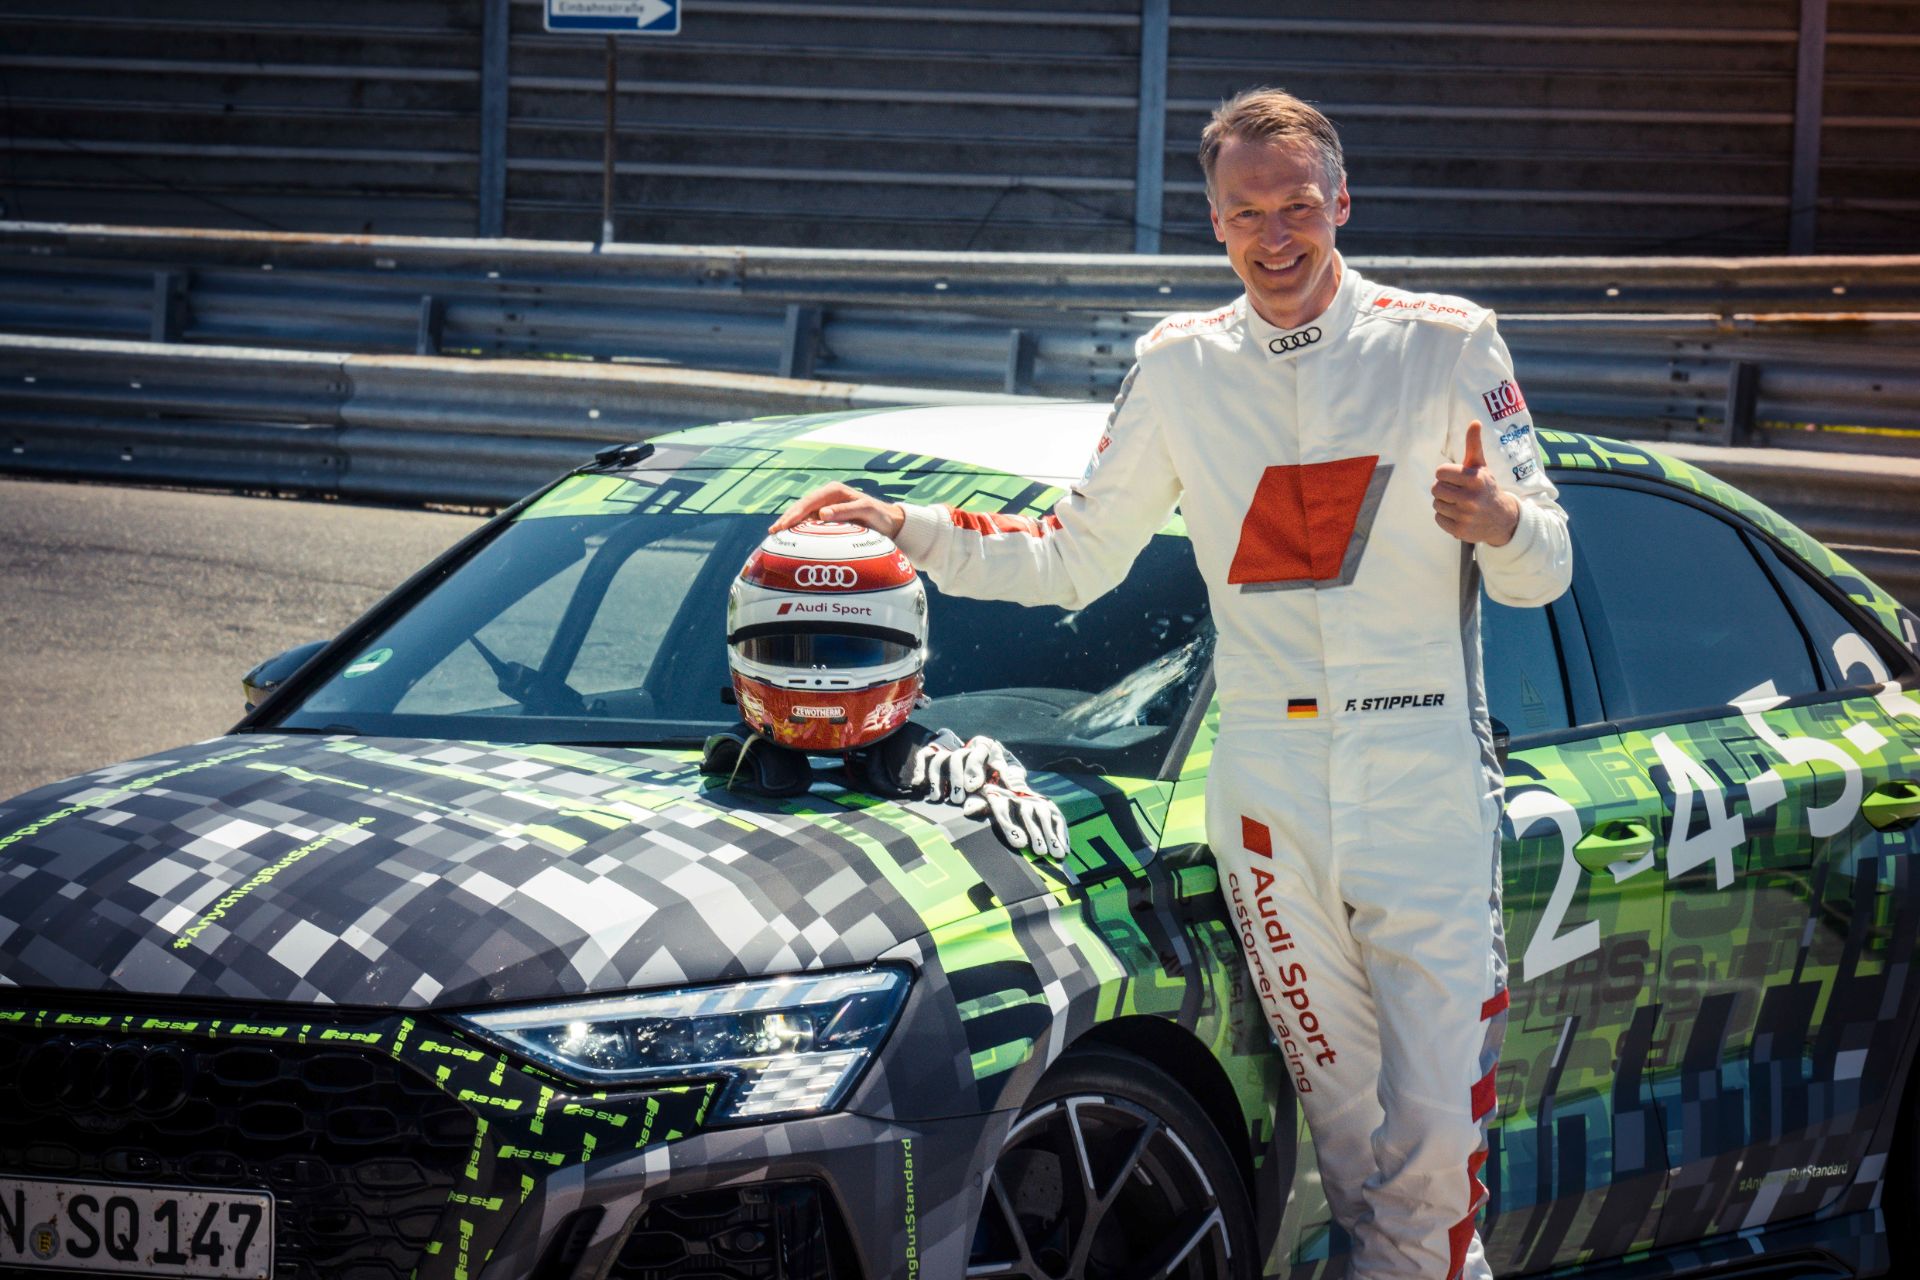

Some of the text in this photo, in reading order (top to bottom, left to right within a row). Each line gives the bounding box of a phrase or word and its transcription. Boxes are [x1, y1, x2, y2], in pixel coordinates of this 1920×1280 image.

[1393, 300, 1469, 318] Audi Sport
[795, 602, 872, 616] Audi Sport
[796, 707, 842, 717] ZEWOTHERM
[1345, 693, 1446, 712] F. STIPPLER
[174, 816, 376, 948] #AnythingButStandard
[1228, 872, 1314, 1094] customer racing
[1250, 866, 1337, 1068] Audi Sport
[66, 1194, 139, 1261] SQ
[153, 1200, 263, 1268] 147
